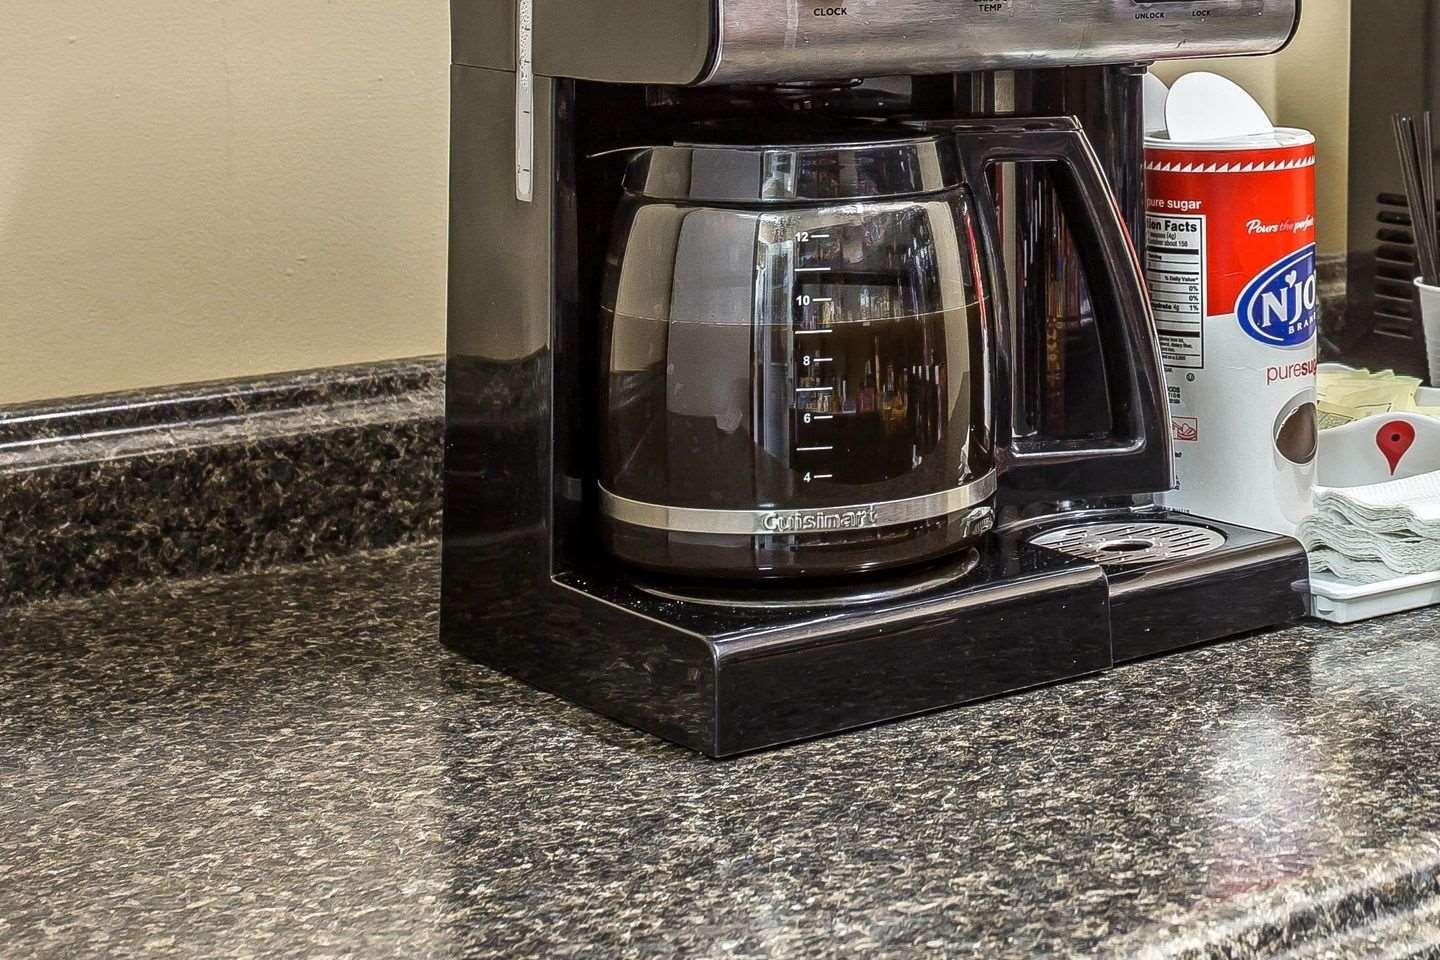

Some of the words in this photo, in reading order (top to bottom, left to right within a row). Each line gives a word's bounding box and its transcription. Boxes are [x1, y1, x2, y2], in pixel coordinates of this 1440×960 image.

[813, 7, 848, 17] CLOCK
[979, 3, 1003, 12] TEMP
[1135, 11, 1165, 20] UNLOCK
[1147, 199, 1165, 209] pure
[1167, 200, 1202, 211] sugar
[1164, 220, 1197, 232] Facts
[1246, 218, 1279, 235] Pours
[796, 231, 809, 242] 12
[796, 295, 810, 306] 10
[803, 355, 810, 366] 8
[803, 413, 811, 423] 6
[803, 472, 811, 483] 4
[761, 503, 879, 531] Cuisinart
